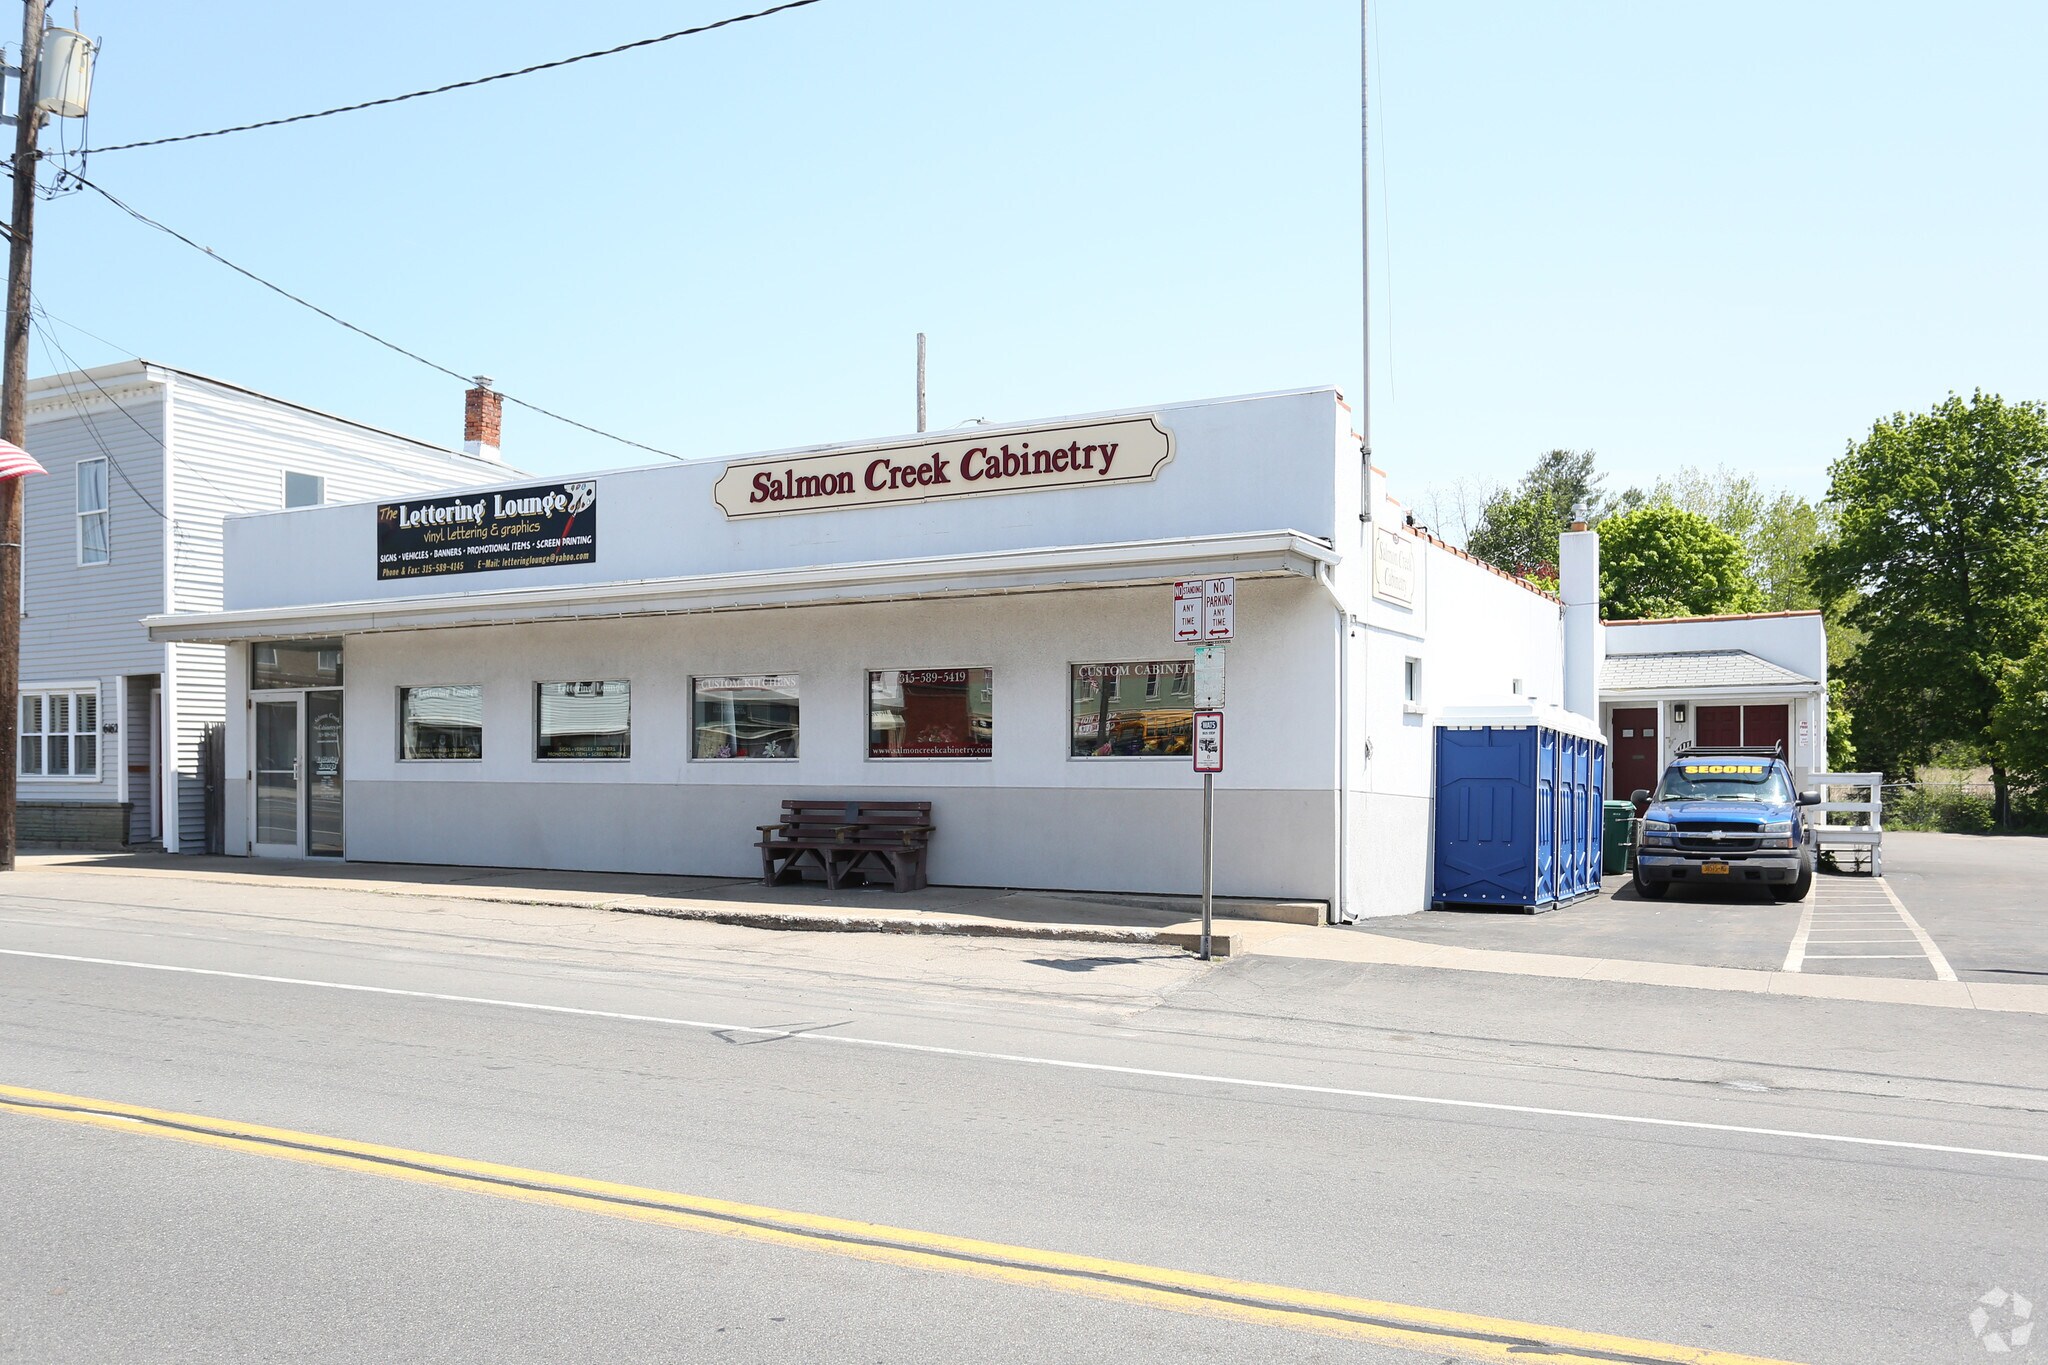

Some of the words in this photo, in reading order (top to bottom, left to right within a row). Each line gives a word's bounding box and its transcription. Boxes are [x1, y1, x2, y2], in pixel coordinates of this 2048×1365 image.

[750, 469, 855, 503] Salmon
[864, 452, 951, 491] Creek
[960, 441, 1119, 482] Cabinetry
[380, 506, 398, 520] The
[399, 499, 486, 529] Lettering
[494, 491, 567, 518] Lounge
[424, 527, 445, 543] vinyl
[447, 525, 488, 540] lettering
[490, 523, 499, 536] &
[501, 519, 541, 537] graphics
[380, 553, 398, 563] SIGNS
[401, 550, 429, 561] VEHICLES
[433, 547, 462, 558] BANNERS
[467, 543, 510, 555] PROMOTIONAL
[511, 541, 531, 551] ITEMS
[536, 538, 561, 549] SCREEN
[562, 535, 592, 546] PRINTING
[382, 567, 399, 577] Phone
[400, 566, 406, 575] &
[407, 565, 420, 575] Fax:
[477, 558, 500, 569] E-Mail:
[502, 552, 589, 567] letteringlounge@yahoo.com
[1175, 585, 1183, 597] NO
[1183, 586, 1202, 594] STANDING
[1213, 581, 1225, 593] NO
[1206, 594, 1233, 607] PARKING
[1182, 604, 1195, 612] ANY
[1213, 608, 1226, 617] ANY
[1182, 617, 1195, 625] TIME
[1212, 618, 1226, 626] TIME
[1079, 664, 1130, 677] CUSTOM
[701, 680, 741, 689] CUSTOM
[744, 677, 796, 687] KITCHENS
[899, 671, 966, 684] 315-589-5419
[872, 745, 992, 756] www.salmoncreekcabinetry.com
[1685, 765, 1763, 774] SECORE
